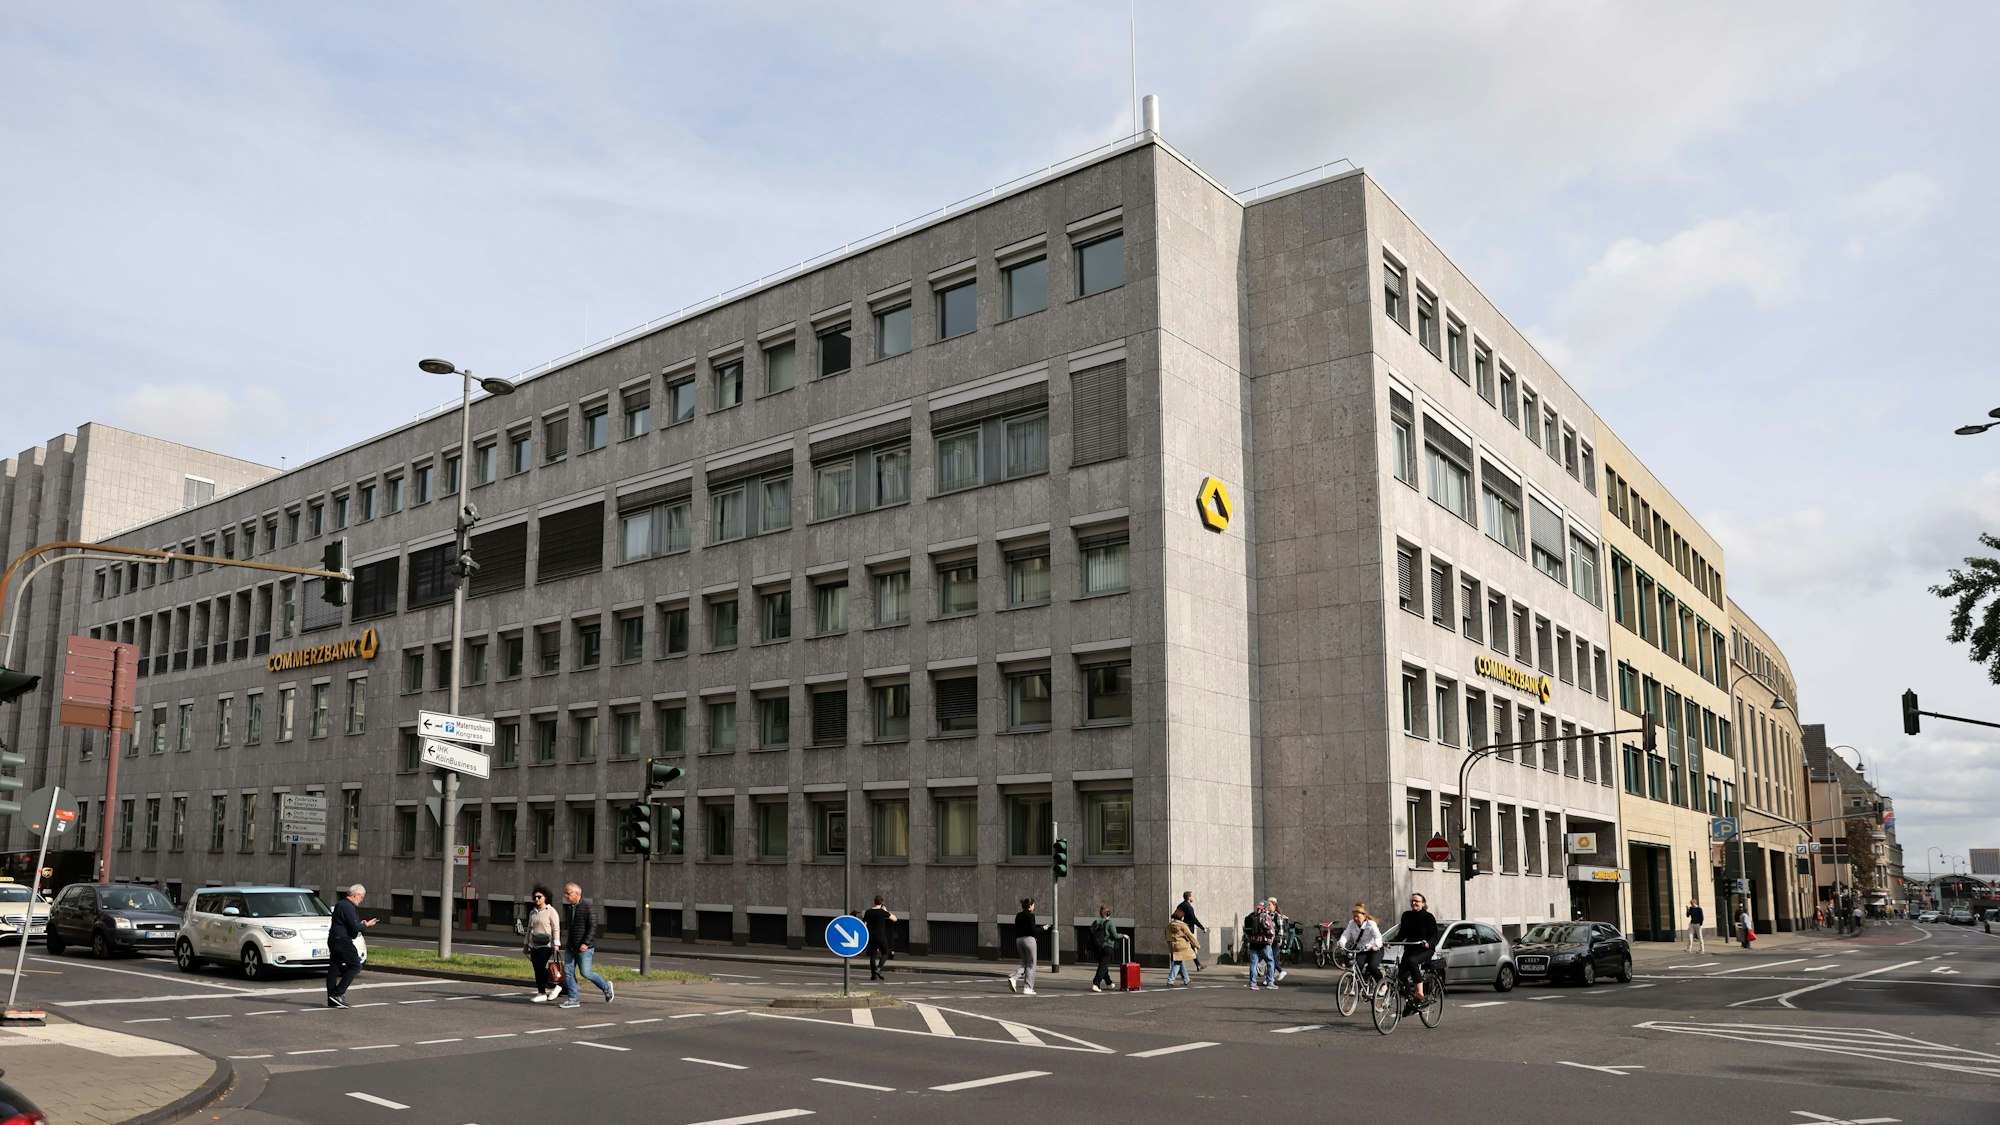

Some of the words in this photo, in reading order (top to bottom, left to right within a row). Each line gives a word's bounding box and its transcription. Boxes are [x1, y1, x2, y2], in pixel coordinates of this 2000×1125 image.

[267, 640, 357, 672] COMMERZBANK
[1478, 655, 1540, 695] COMMERZBANK
[456, 721, 491, 733] Maternushaus
[456, 730, 483, 740] Kongress
[437, 745, 449, 754] IHK
[435, 754, 477, 771] KölnBusiness
[1721, 824, 1732, 835] P
